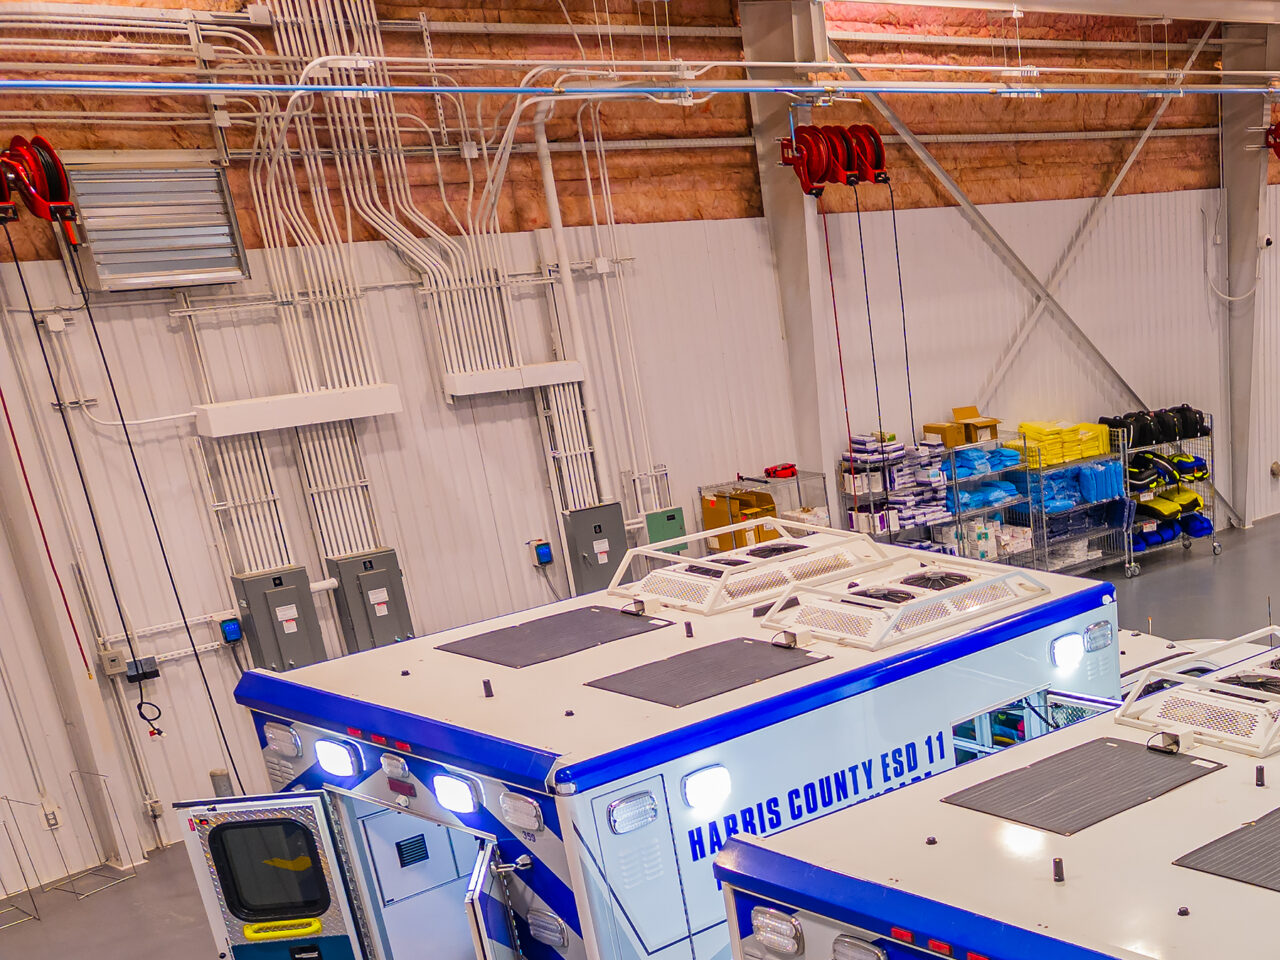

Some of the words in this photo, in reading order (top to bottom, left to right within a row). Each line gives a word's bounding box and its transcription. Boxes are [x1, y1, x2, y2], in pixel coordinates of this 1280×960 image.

[688, 797, 782, 862] HARRIS
[788, 758, 873, 821] COUNTY
[880, 742, 918, 783] ESD
[925, 731, 945, 764] 11
